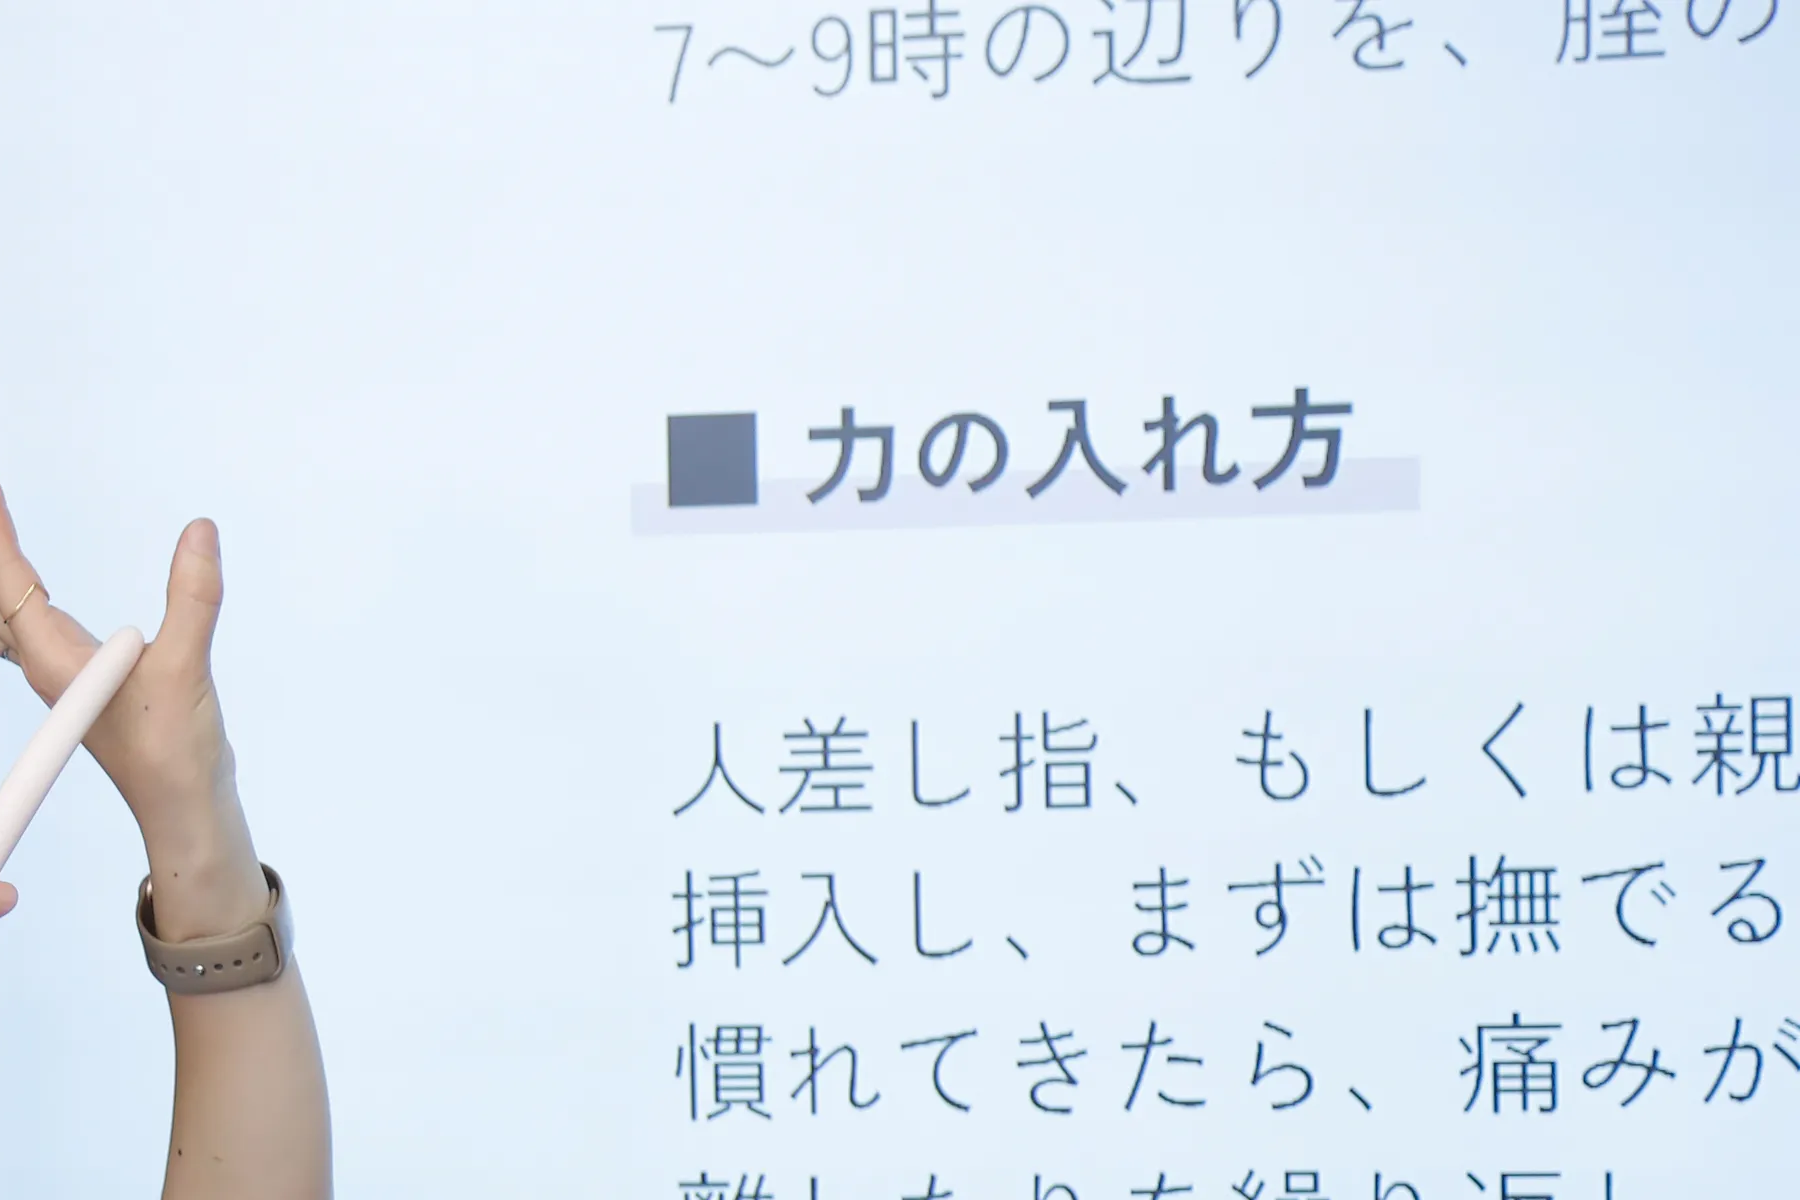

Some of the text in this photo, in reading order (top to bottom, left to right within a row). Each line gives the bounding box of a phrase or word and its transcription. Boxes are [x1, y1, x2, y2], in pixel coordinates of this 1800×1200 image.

[806, 387, 1353, 504] 力の入れ方
[672, 691, 1800, 817] 人差し指、もしくは親
[671, 853, 1783, 970] 挿入し、まずは撫でる
[675, 1011, 1800, 1122] 慣れてきたら、痛みが
